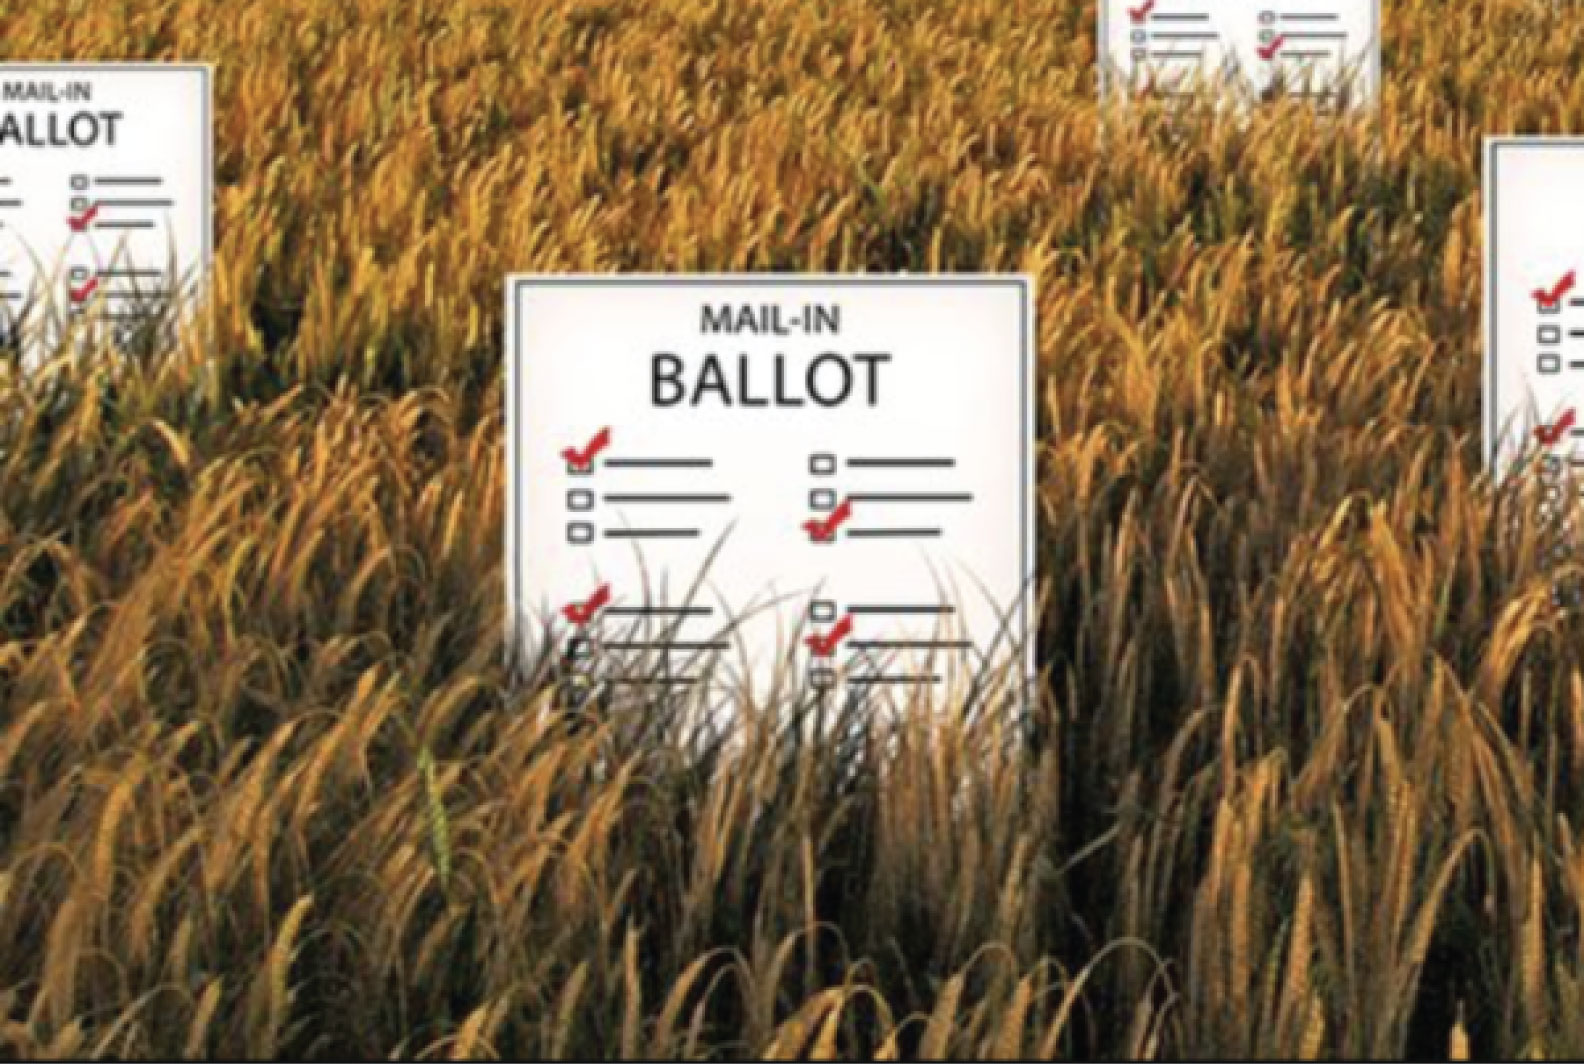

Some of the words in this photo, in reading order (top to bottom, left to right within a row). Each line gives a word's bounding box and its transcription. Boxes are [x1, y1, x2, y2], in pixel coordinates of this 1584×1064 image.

[2, 81, 92, 103] MAIL-IN
[699, 303, 841, 336] MAIL-IN
[650, 351, 893, 408] BALLOT
